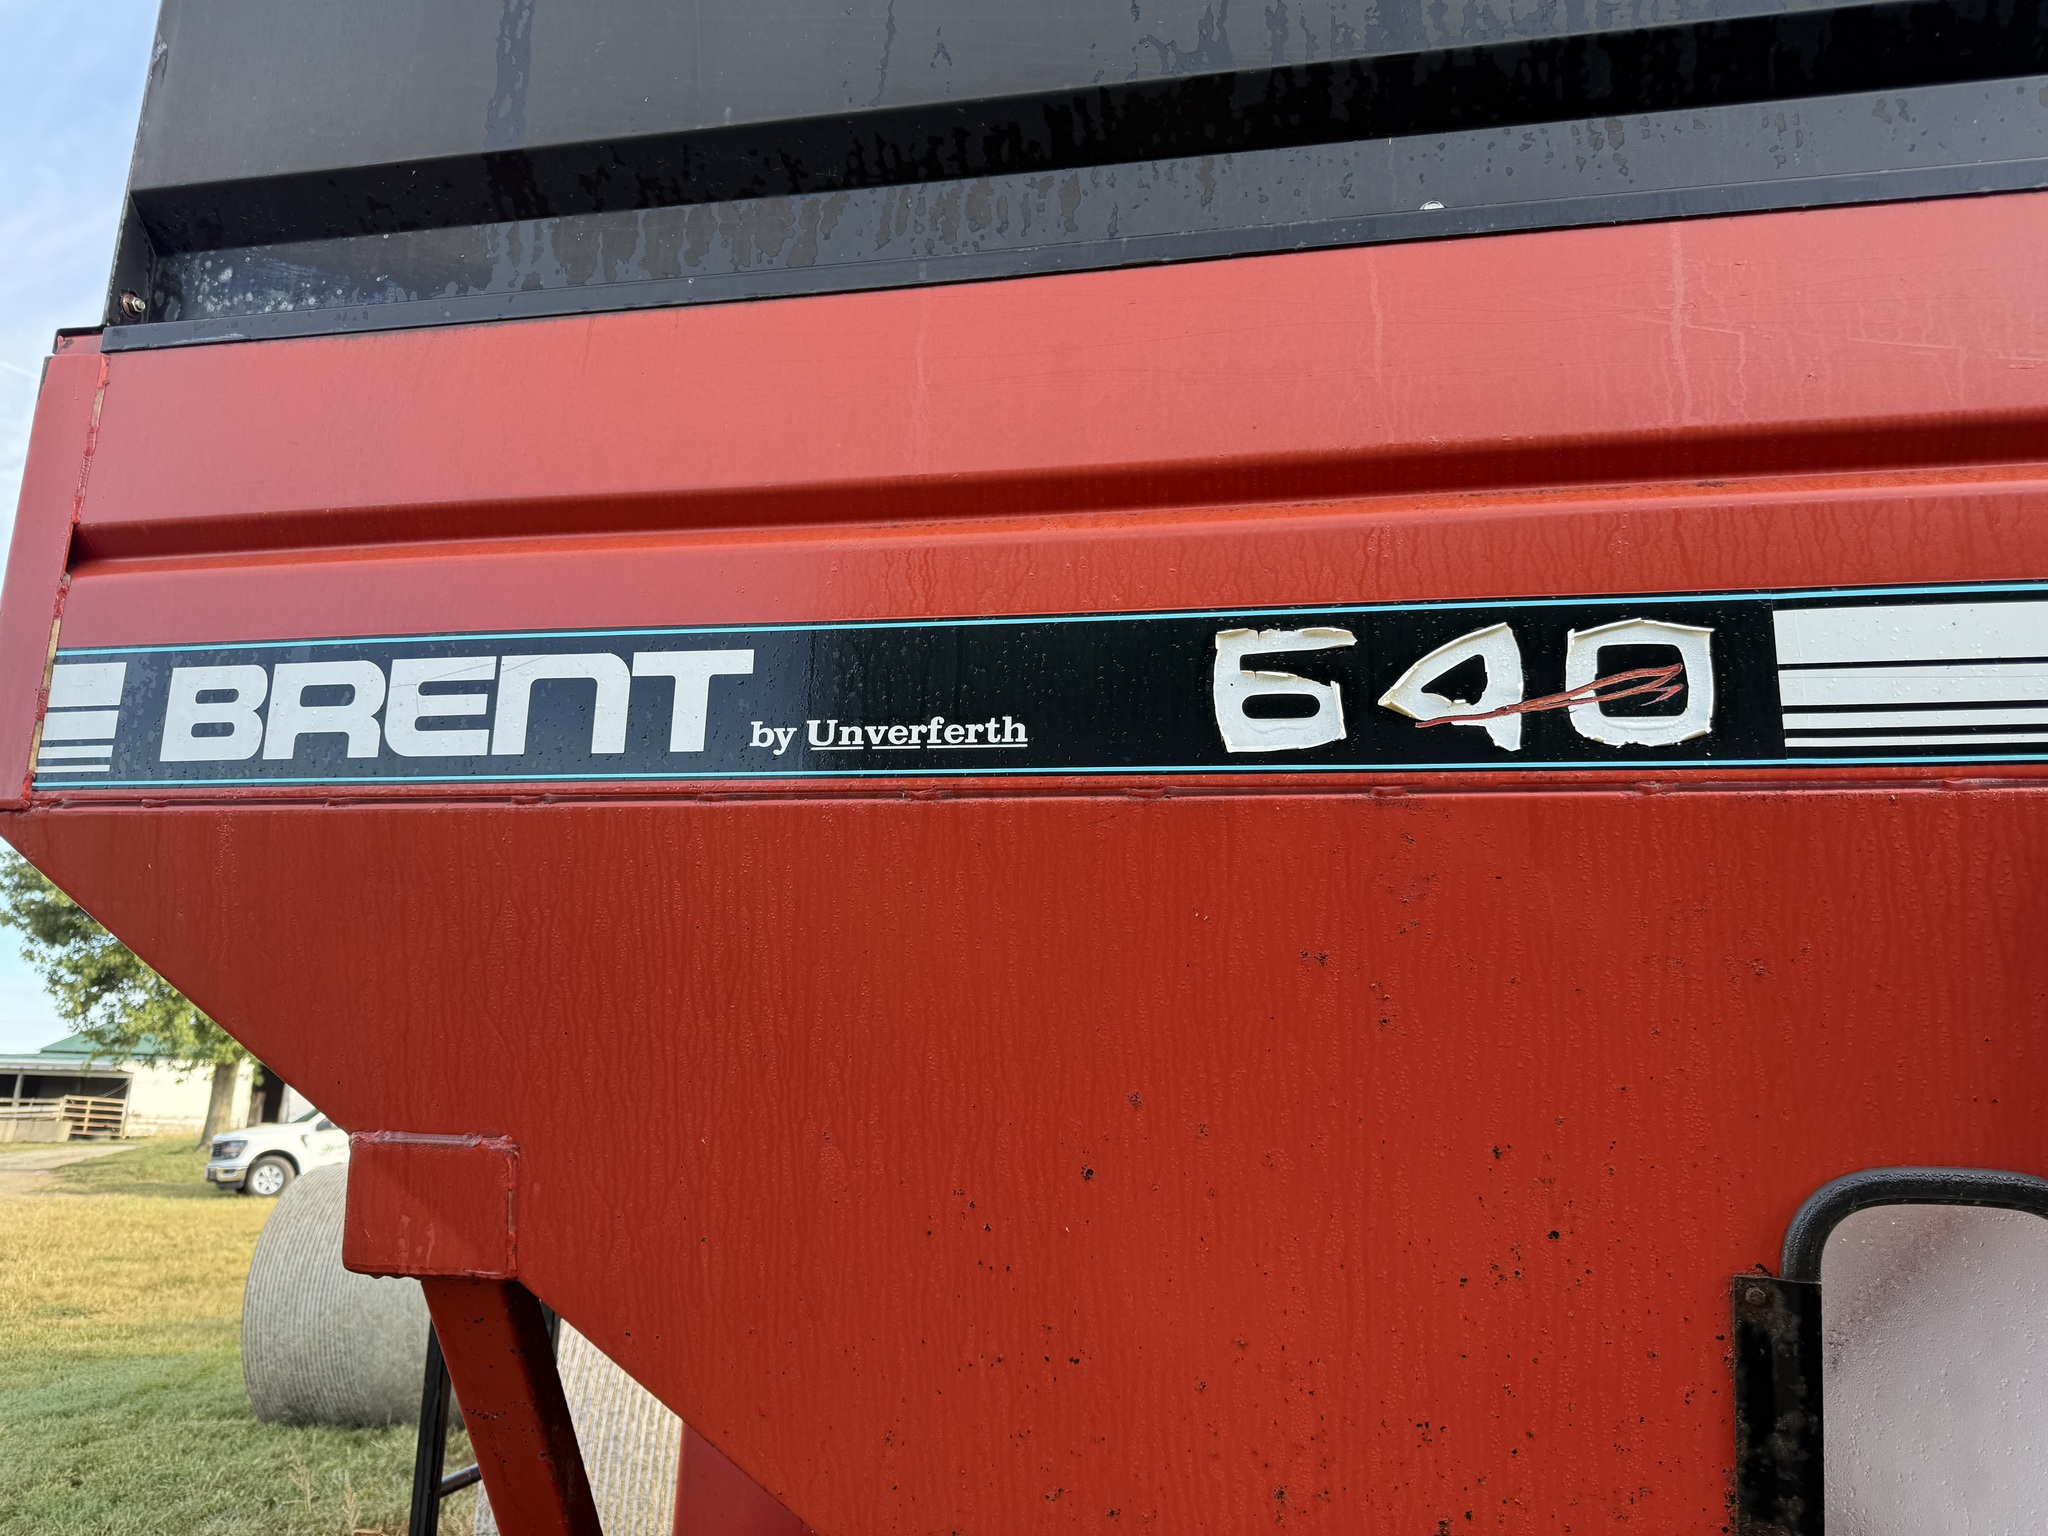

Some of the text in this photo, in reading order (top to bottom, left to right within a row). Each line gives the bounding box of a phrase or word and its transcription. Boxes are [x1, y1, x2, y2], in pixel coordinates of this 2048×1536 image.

[160, 648, 755, 762] BRENT
[749, 716, 1029, 756] by Unverferth
[1212, 618, 1714, 753] 640
